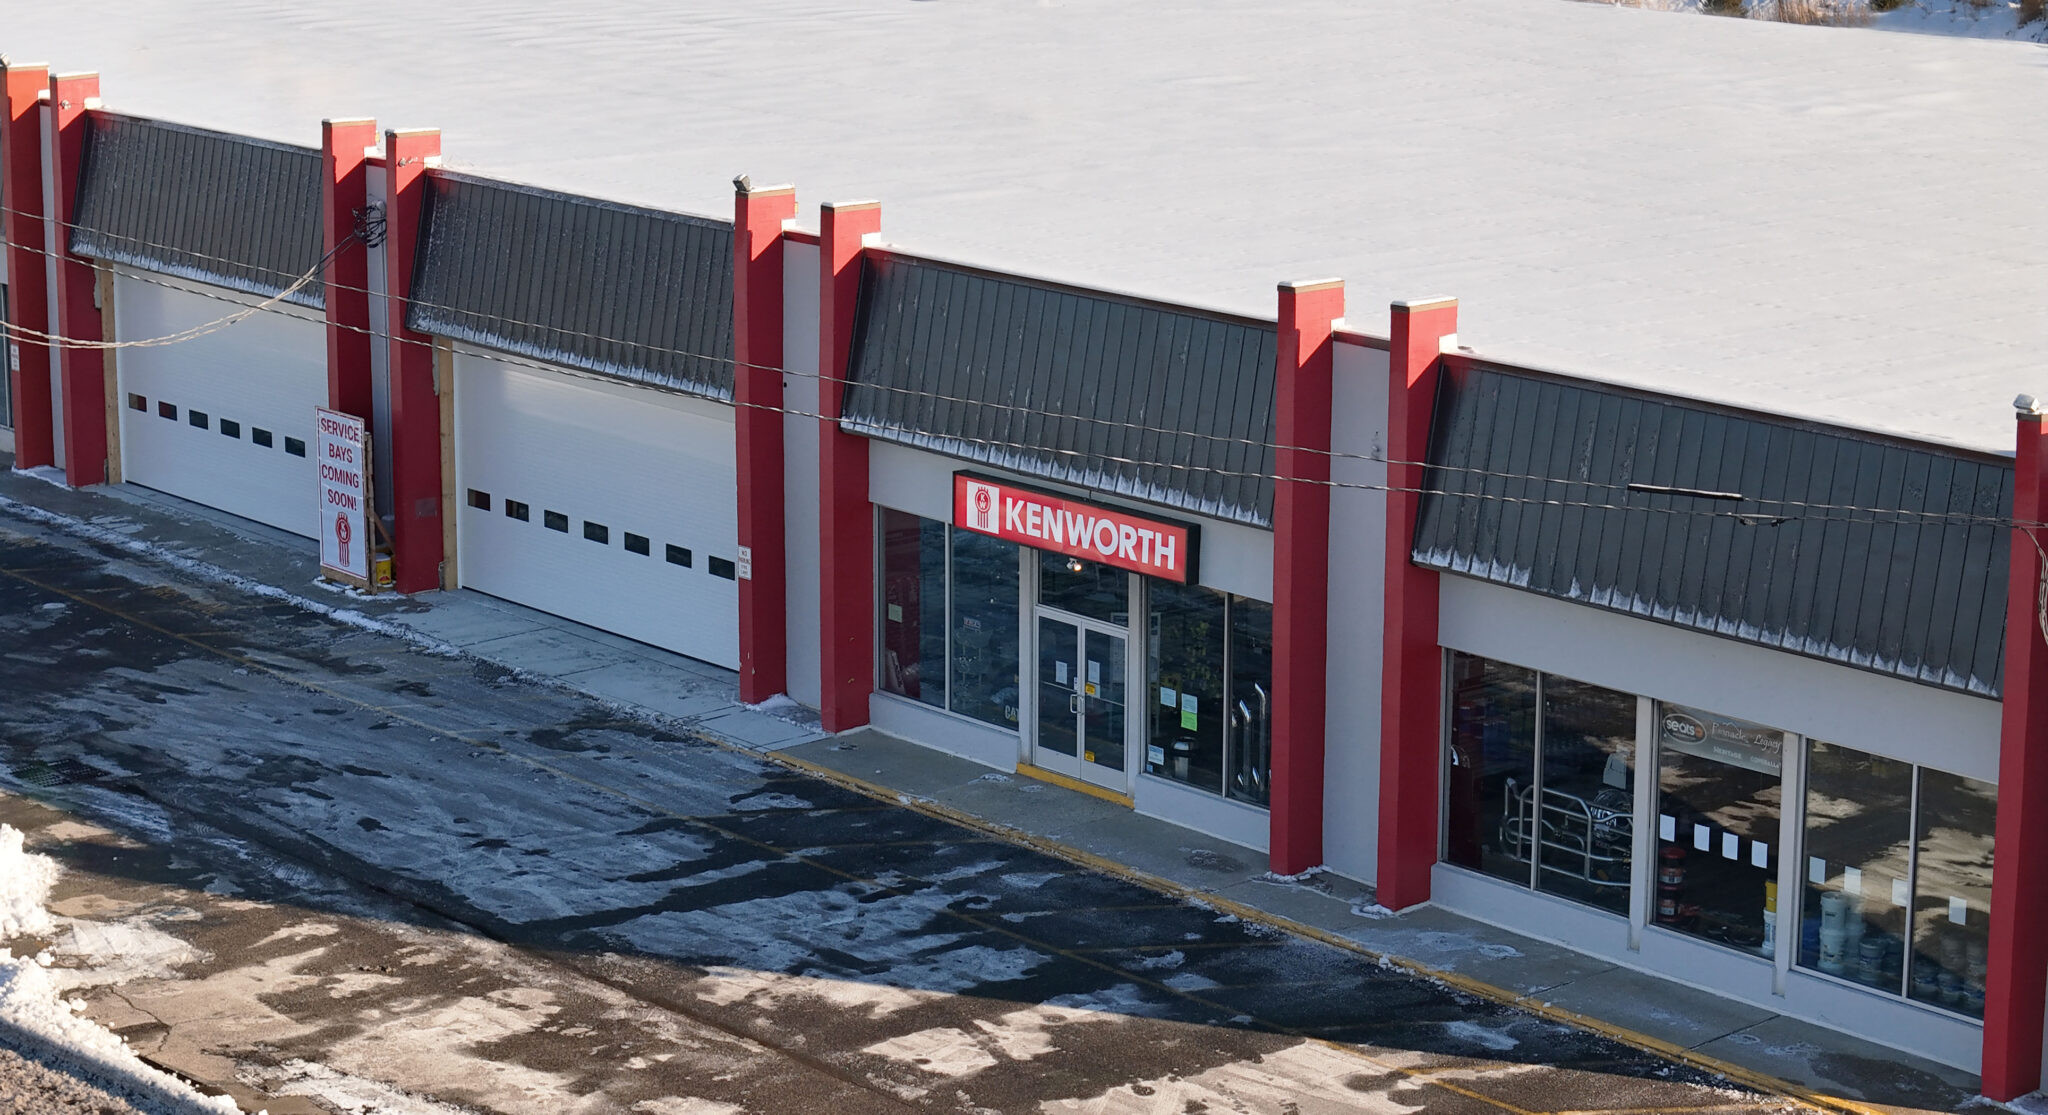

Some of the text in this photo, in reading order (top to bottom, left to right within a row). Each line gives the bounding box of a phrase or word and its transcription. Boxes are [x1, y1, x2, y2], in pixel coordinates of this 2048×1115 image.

[320, 417, 360, 443] SERVICE
[328, 442, 353, 464] BAYS
[321, 463, 360, 489] COMING
[327, 488, 357, 511] SOON!
[1005, 497, 1176, 571] KENWORTH
[1666, 719, 1696, 736] seats
[1712, 721, 1747, 741] Pinnacle
[1753, 733, 1782, 754] Legacy
